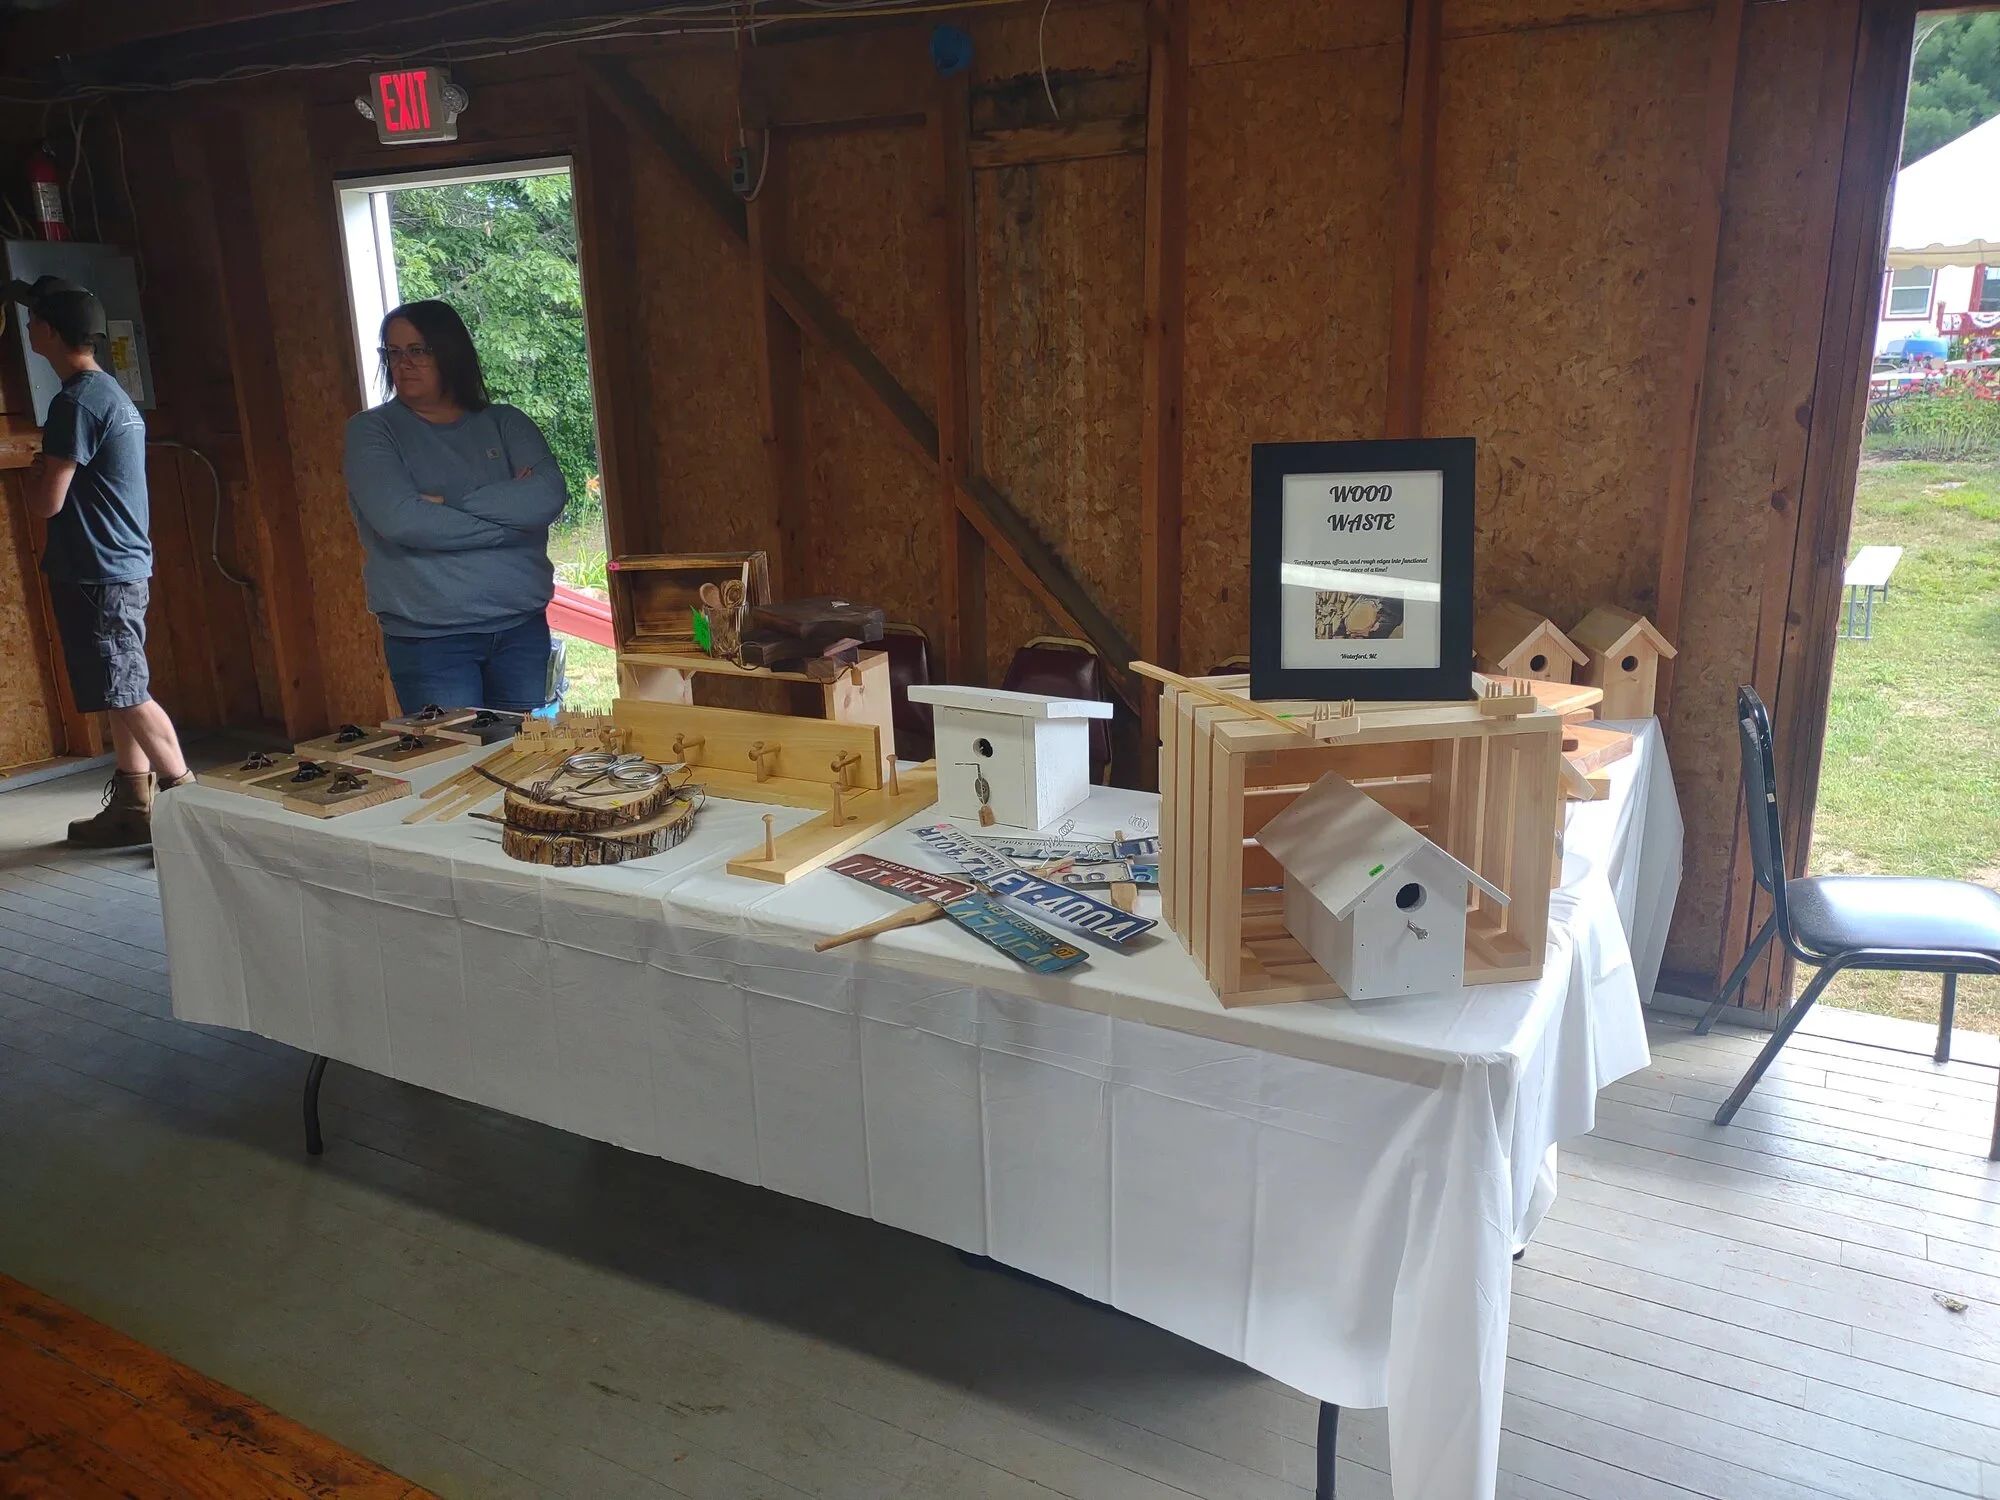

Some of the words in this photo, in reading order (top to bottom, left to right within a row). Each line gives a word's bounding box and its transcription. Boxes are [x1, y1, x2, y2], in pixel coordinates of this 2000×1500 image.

[379, 71, 431, 132] EXIT
[1329, 485, 1393, 503] WOOD
[1327, 513, 1396, 533] WASTE
[1361, 558, 1376, 566] rough
[1376, 558, 1391, 566] edges
[1400, 557, 1429, 566] functional
[985, 900, 1010, 918] NEW
[1008, 918, 1056, 945] JERSEY
[1056, 948, 1075, 958] 07
